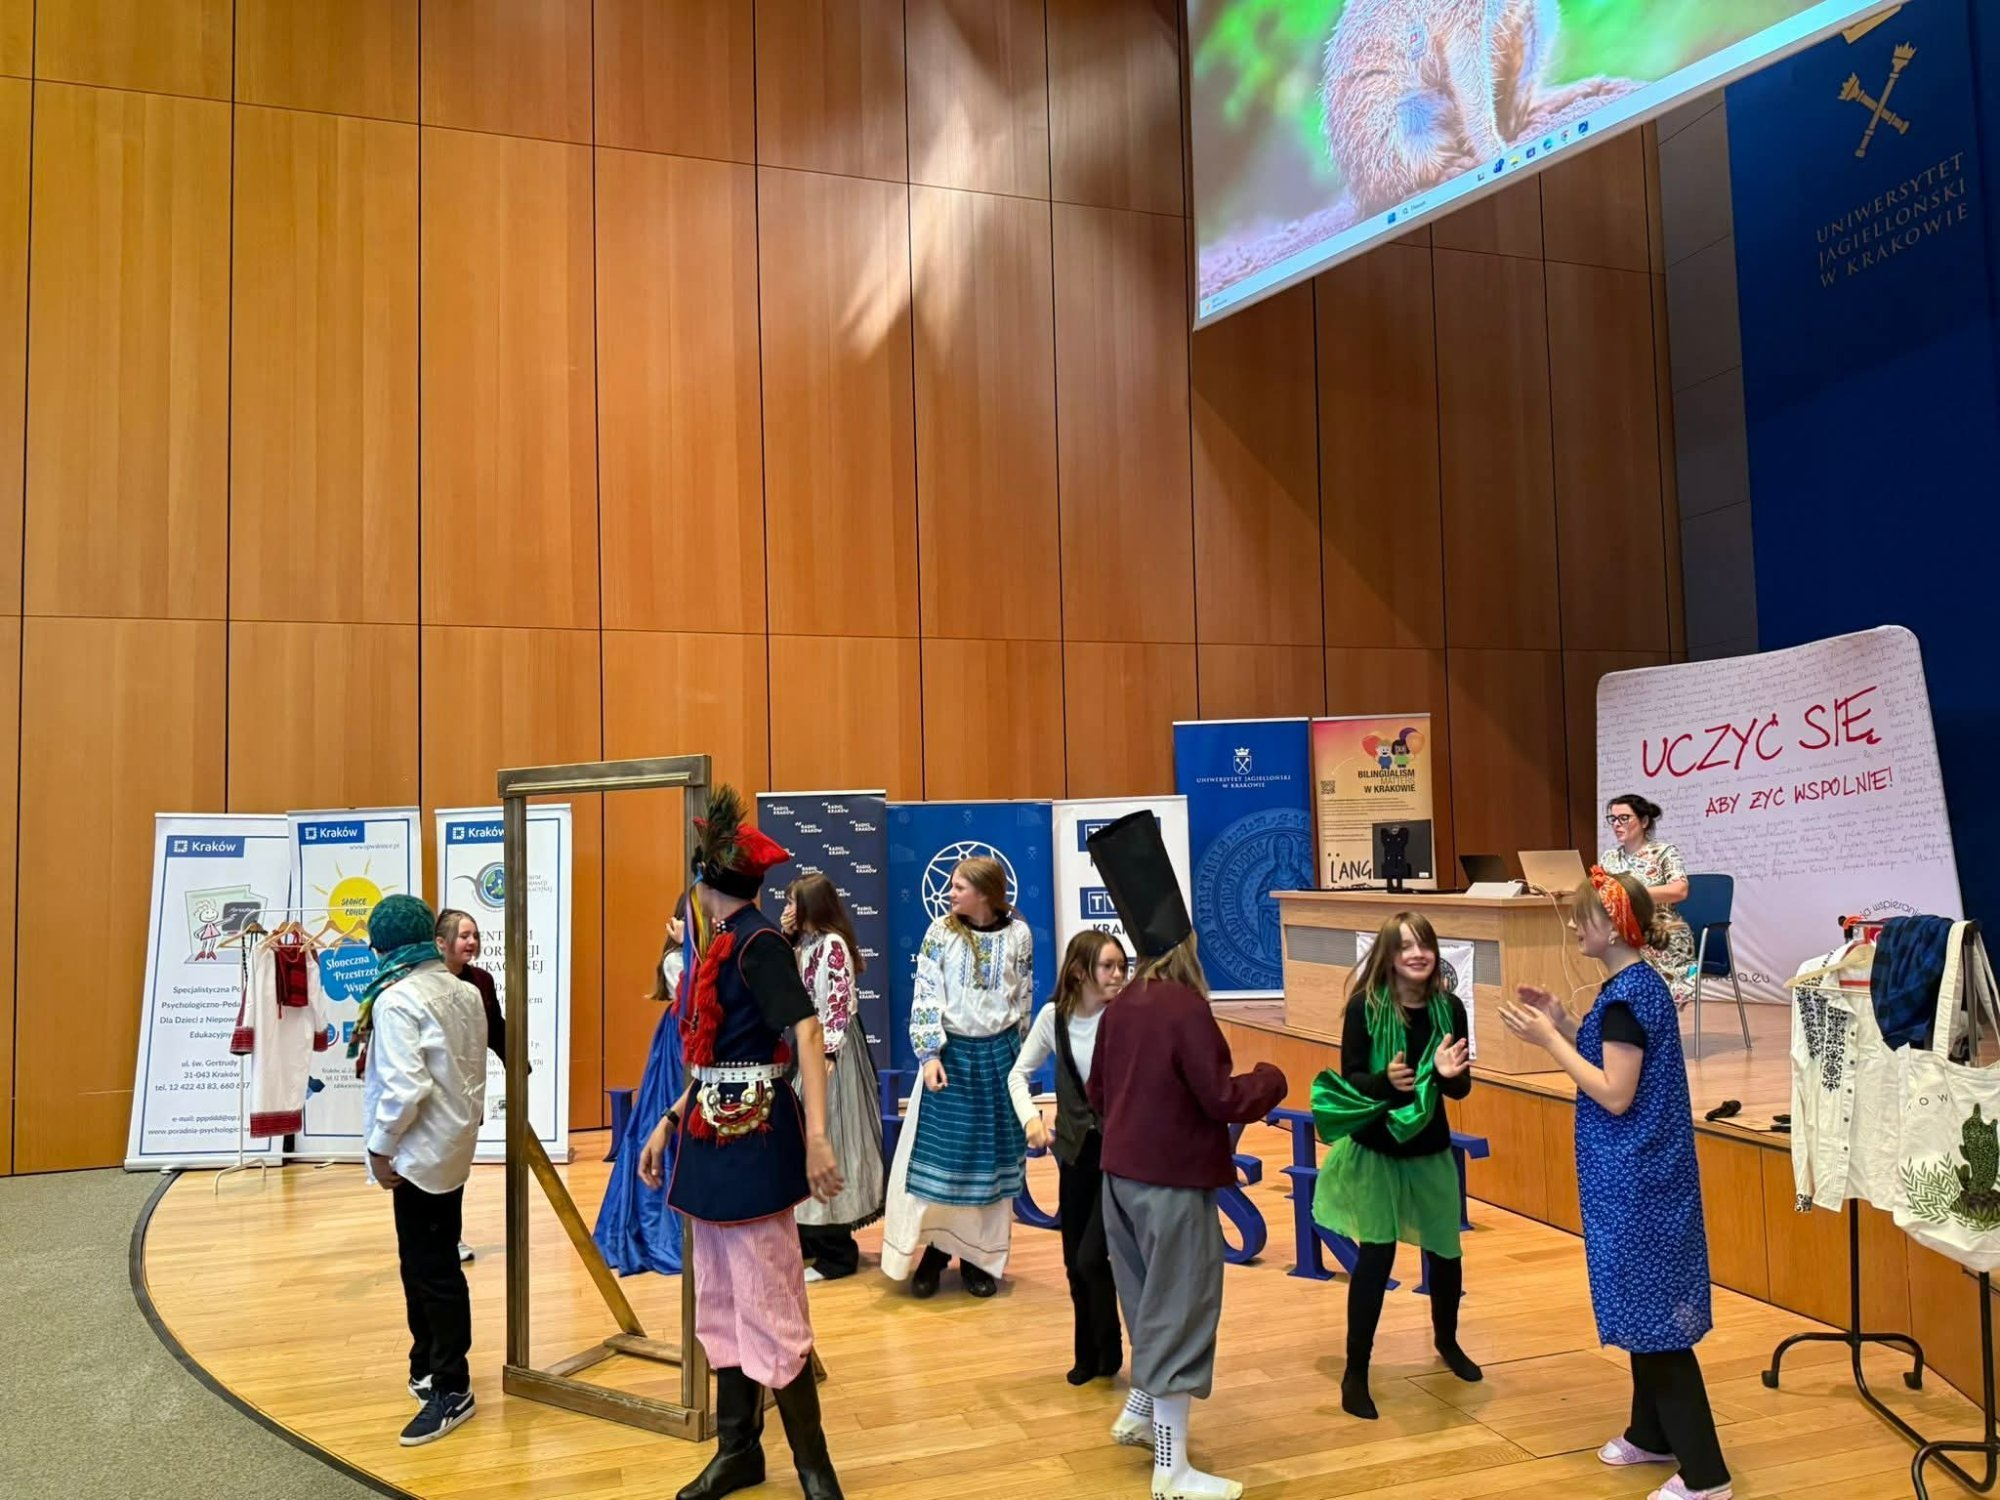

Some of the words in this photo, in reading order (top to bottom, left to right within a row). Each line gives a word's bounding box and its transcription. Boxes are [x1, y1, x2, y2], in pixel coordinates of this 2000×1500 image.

[1816, 152, 1964, 243] UNIWERSYTET
[1820, 268, 1836, 288] W
[1847, 203, 1968, 276] KRAKOWIE
[1642, 712, 1783, 777] UCZYĆ
[1799, 686, 1882, 750] SIĘ
[1358, 769, 1415, 778] BILINGUALISM
[1374, 784, 1416, 793] KRAKOWIE
[1705, 793, 1740, 817] ABY
[320, 826, 358, 838] Kraków
[192, 840, 236, 852] Kraków
[1331, 860, 1372, 883] LANG
[1091, 895, 1116, 910] TV
[173, 986, 229, 994] Specjalistyczna
[161, 1001, 240, 1010] Psychologiczno-Peda
[160, 1016, 173, 1024] Dla
[175, 1016, 198, 1024] Dzieci
